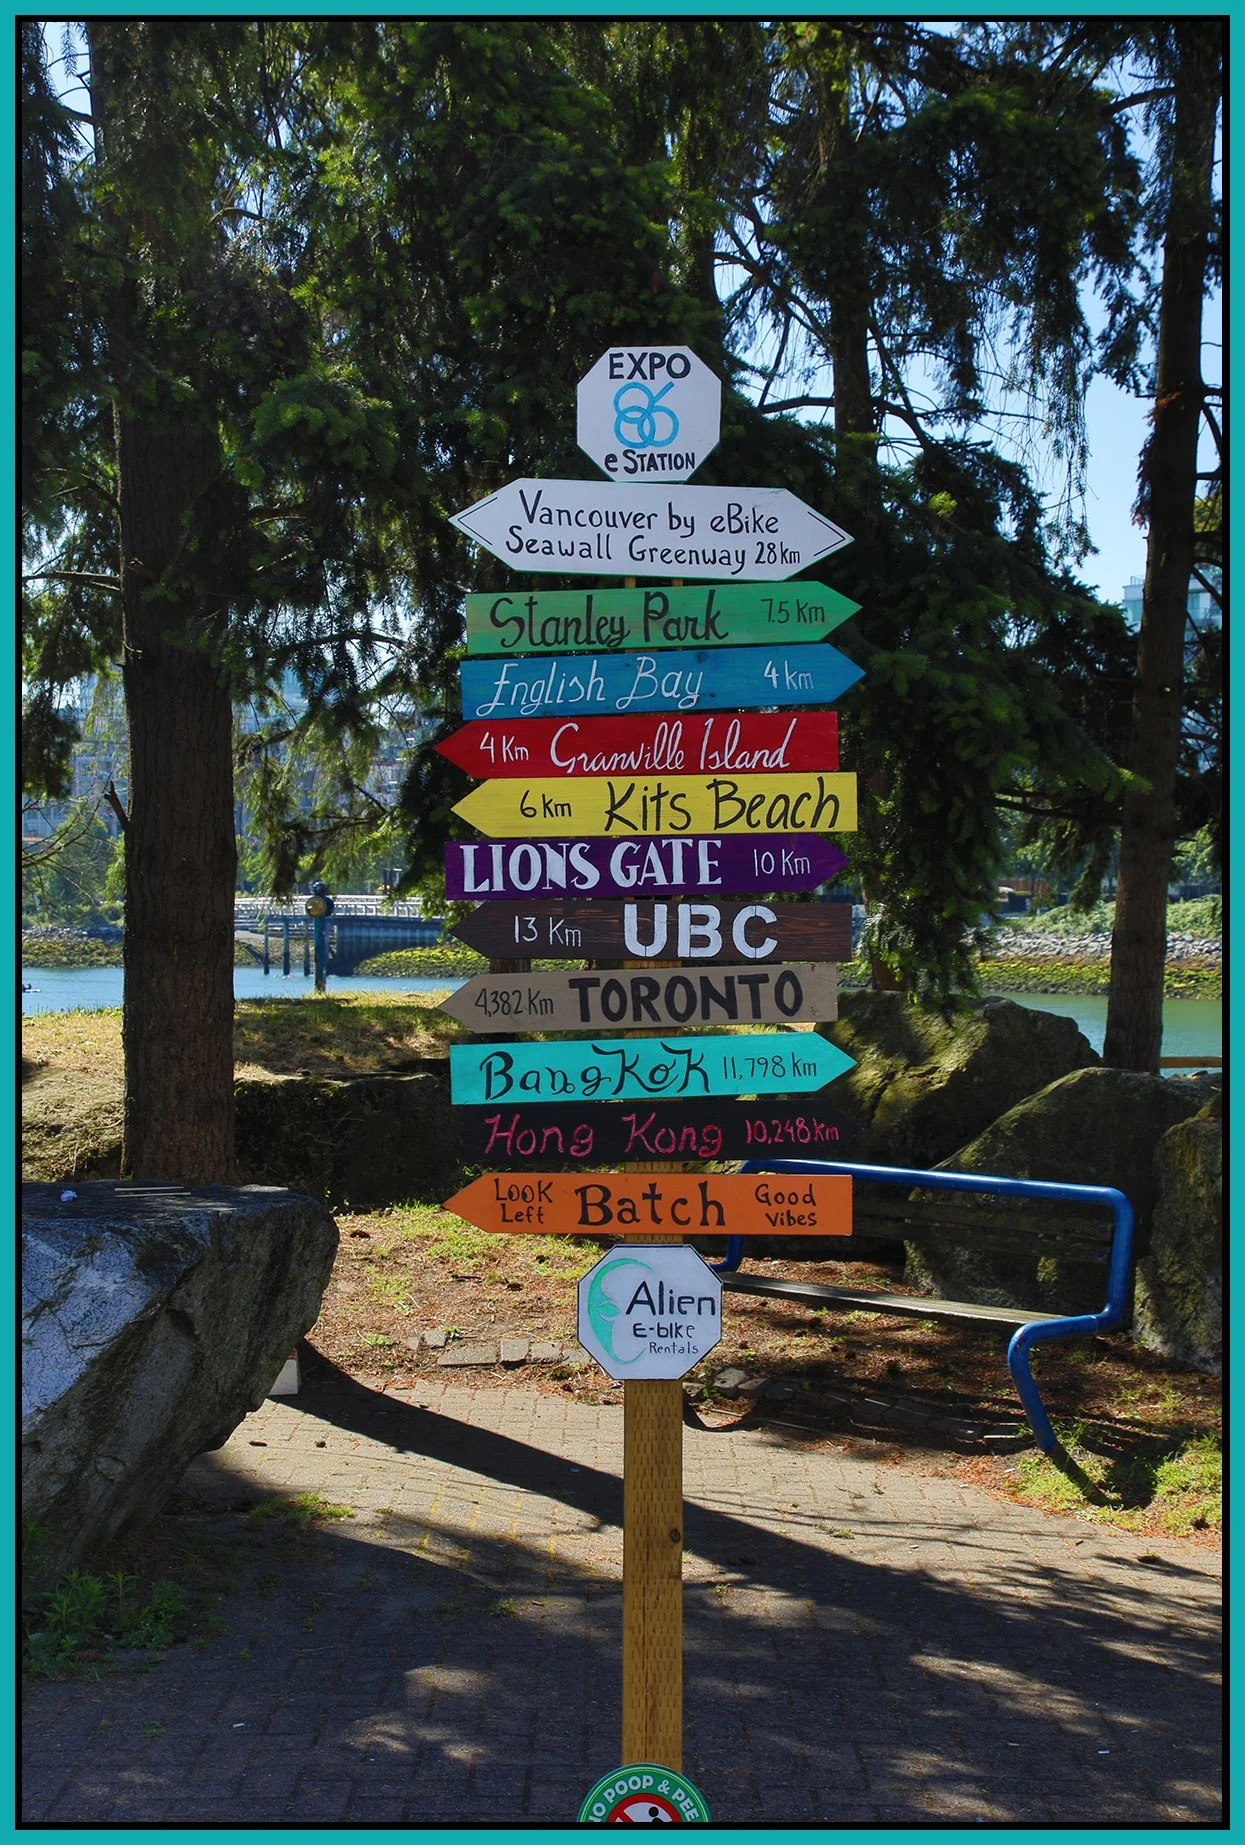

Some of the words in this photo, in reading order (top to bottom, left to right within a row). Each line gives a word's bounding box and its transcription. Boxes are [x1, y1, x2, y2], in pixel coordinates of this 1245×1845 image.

[609, 352, 691, 380] EXPO
[518, 489, 658, 531] Vancouver
[668, 502, 696, 538] by
[710, 502, 780, 534] eBike
[505, 525, 613, 560] Seawall
[628, 535, 746, 575] Greenway
[489, 594, 631, 648] Stanley
[643, 589, 729, 642] Park
[761, 598, 790, 624] 7.5
[475, 659, 606, 715] English
[616, 655, 704, 709] Bay
[763, 661, 778, 689] 4
[479, 731, 496, 763] 4
[549, 720, 685, 773] Granville
[699, 717, 798, 771] Island
[519, 789, 537, 818] 6
[604, 780, 692, 832] Kits
[706, 776, 840, 830] Beach
[460, 842, 600, 892] LIONS
[610, 838, 723, 888] GATE
[753, 849, 775, 876] 10
[513, 915, 537, 943] 13
[624, 903, 778, 959] UBC
[475, 987, 524, 1018] 4,382
[569, 970, 802, 1023] TORONTO
[723, 1055, 786, 1080] 11,798
[484, 1113, 595, 1156] Hong
[621, 1112, 723, 1158] Kong
[501, 1203, 544, 1224] Left
[575, 1181, 725, 1227] Batch
[755, 1183, 817, 1207] Good
[765, 1211, 818, 1228] Vibes
[626, 1280, 716, 1316] Alien
[649, 1341, 699, 1354] Rentals
[603, 1775, 654, 1803] POOP
[657, 1779, 671, 1795] &
[671, 1788, 699, 1822] PEE
